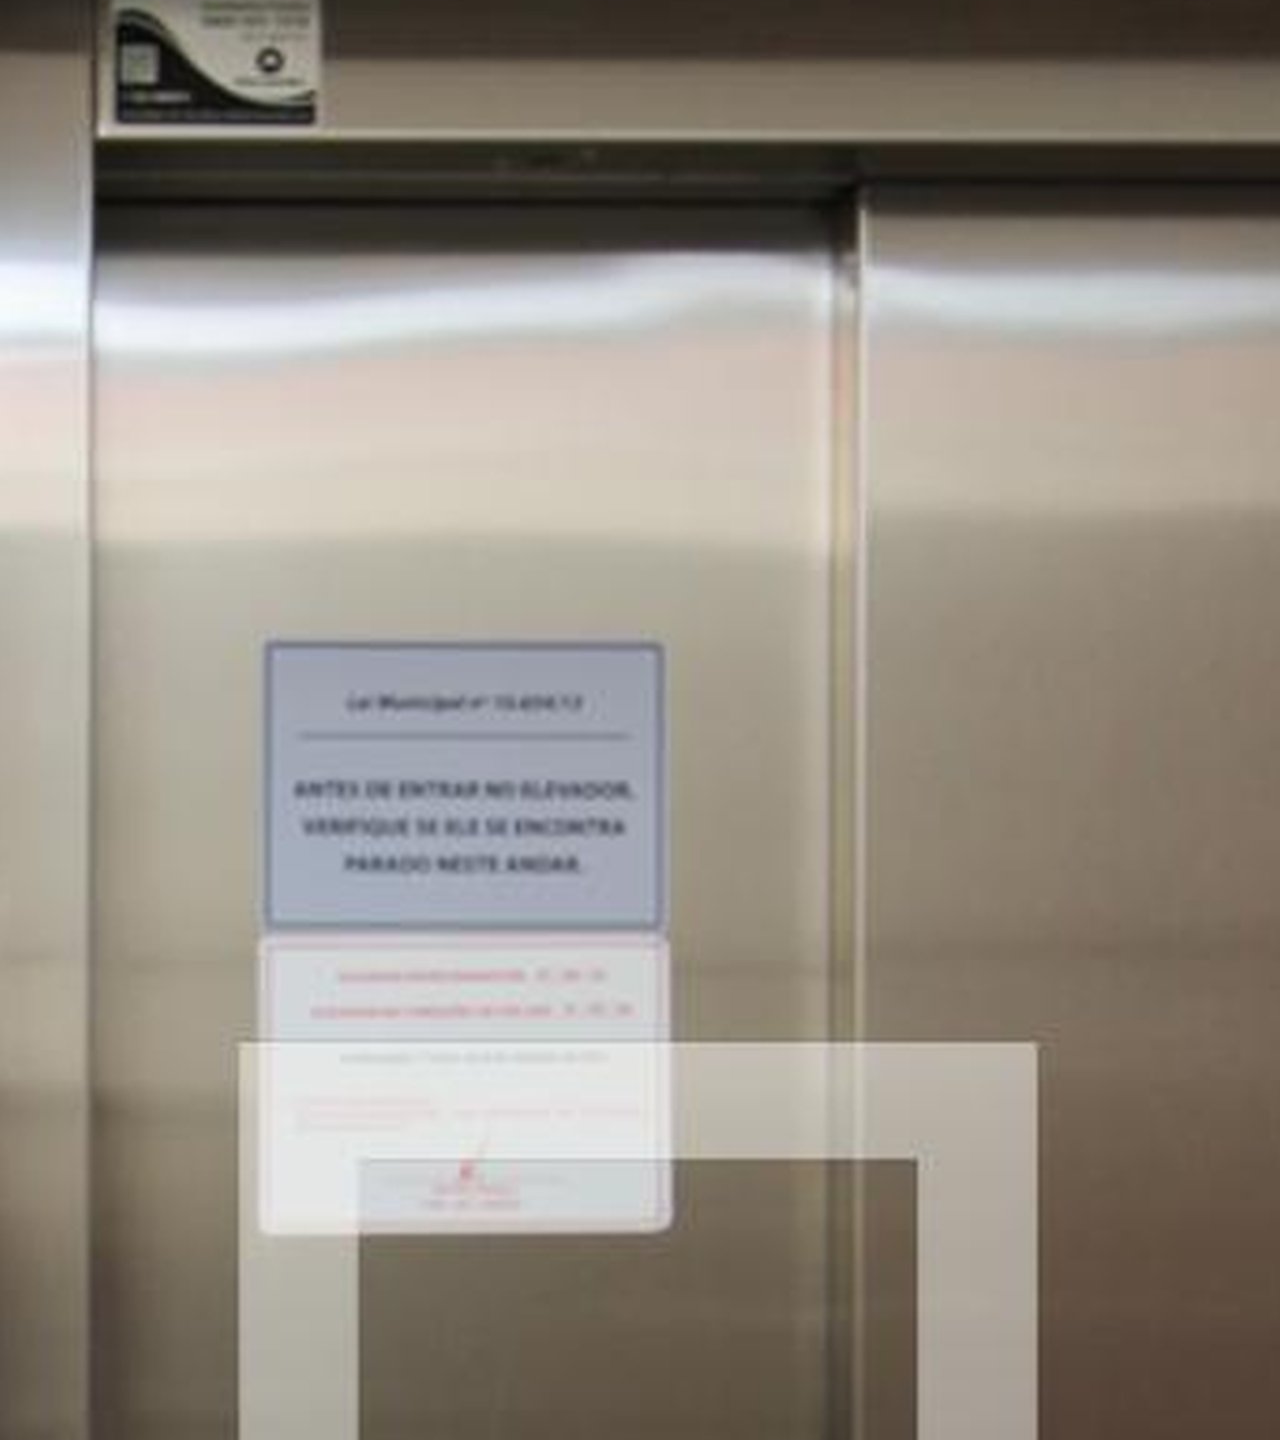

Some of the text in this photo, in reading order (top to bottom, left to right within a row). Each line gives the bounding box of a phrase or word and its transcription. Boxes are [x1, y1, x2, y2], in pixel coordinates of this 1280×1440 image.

[377, 694, 464, 715] Municipal
[293, 779, 360, 799] ANTES
[365, 779, 393, 799] DE
[397, 779, 480, 799] ENTRAR
[484, 779, 516, 799] NO
[302, 817, 626, 838] VERIFIQUE SE ELE SE ENCONTRA
[343, 854, 432, 874] PARADO
[435, 854, 499, 874] NESTE
